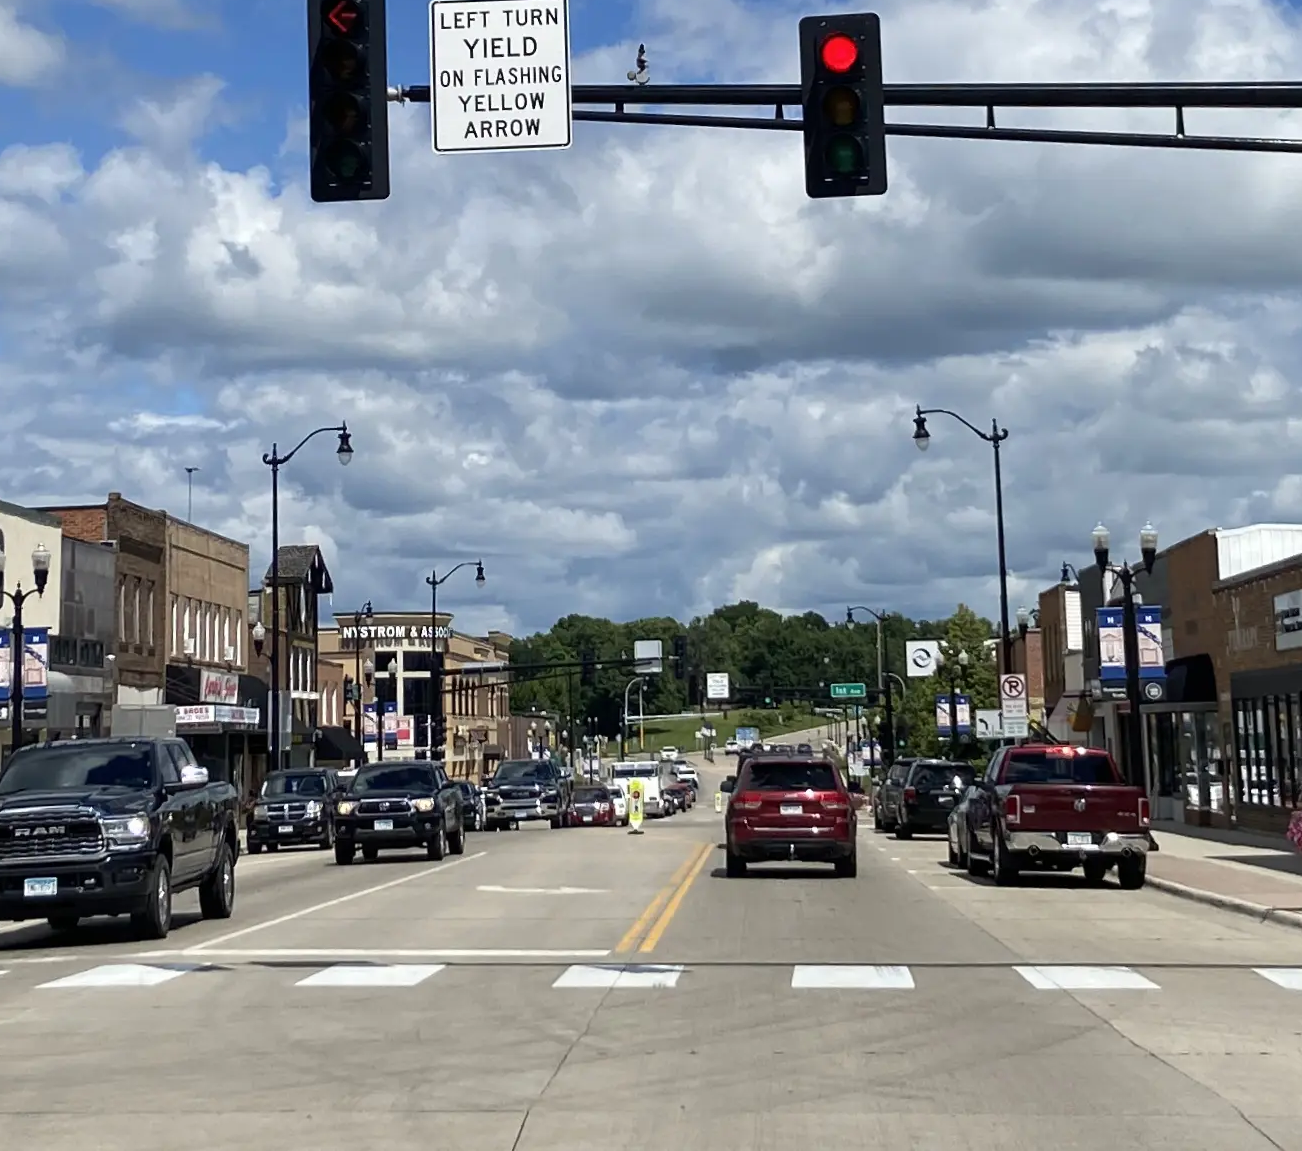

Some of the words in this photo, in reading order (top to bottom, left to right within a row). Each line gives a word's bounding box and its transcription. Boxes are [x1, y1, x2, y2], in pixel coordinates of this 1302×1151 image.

[441, 11, 490, 30] LEFT
[503, 8, 558, 27] TURN
[464, 36, 537, 59] YIELD
[440, 70, 464, 88] ON
[475, 65, 562, 87] FLASHING
[458, 92, 545, 113] YELLOW
[464, 118, 540, 139] ARROW
[343, 626, 405, 639] NYSTROM
[410, 626, 418, 638] &
[15, 825, 65, 837] RAM
